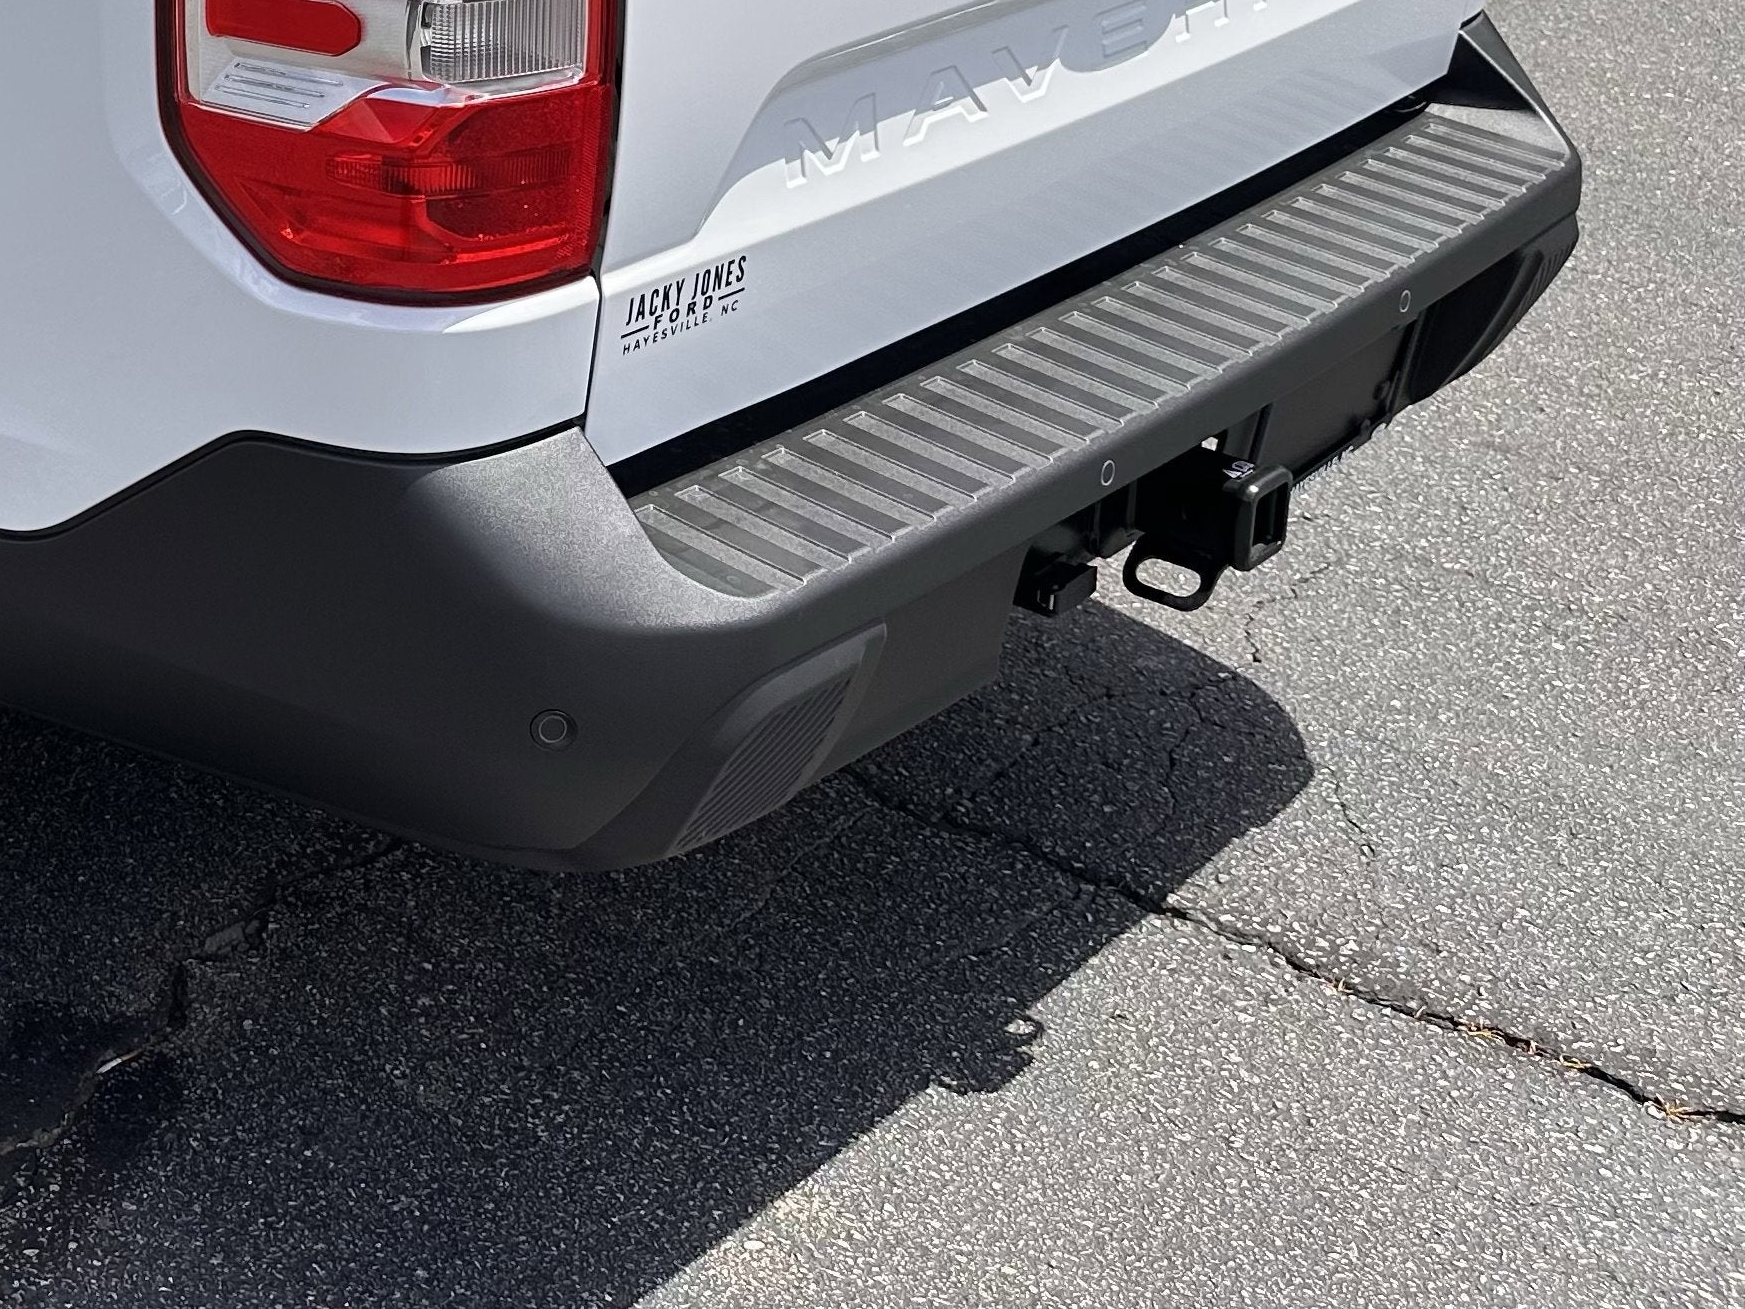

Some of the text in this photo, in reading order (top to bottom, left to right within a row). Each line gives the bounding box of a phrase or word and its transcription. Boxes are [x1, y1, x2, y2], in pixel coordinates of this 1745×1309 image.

[625, 255, 747, 326] JACKY JONES
[720, 299, 739, 316] NC
[653, 294, 713, 331] FORD
